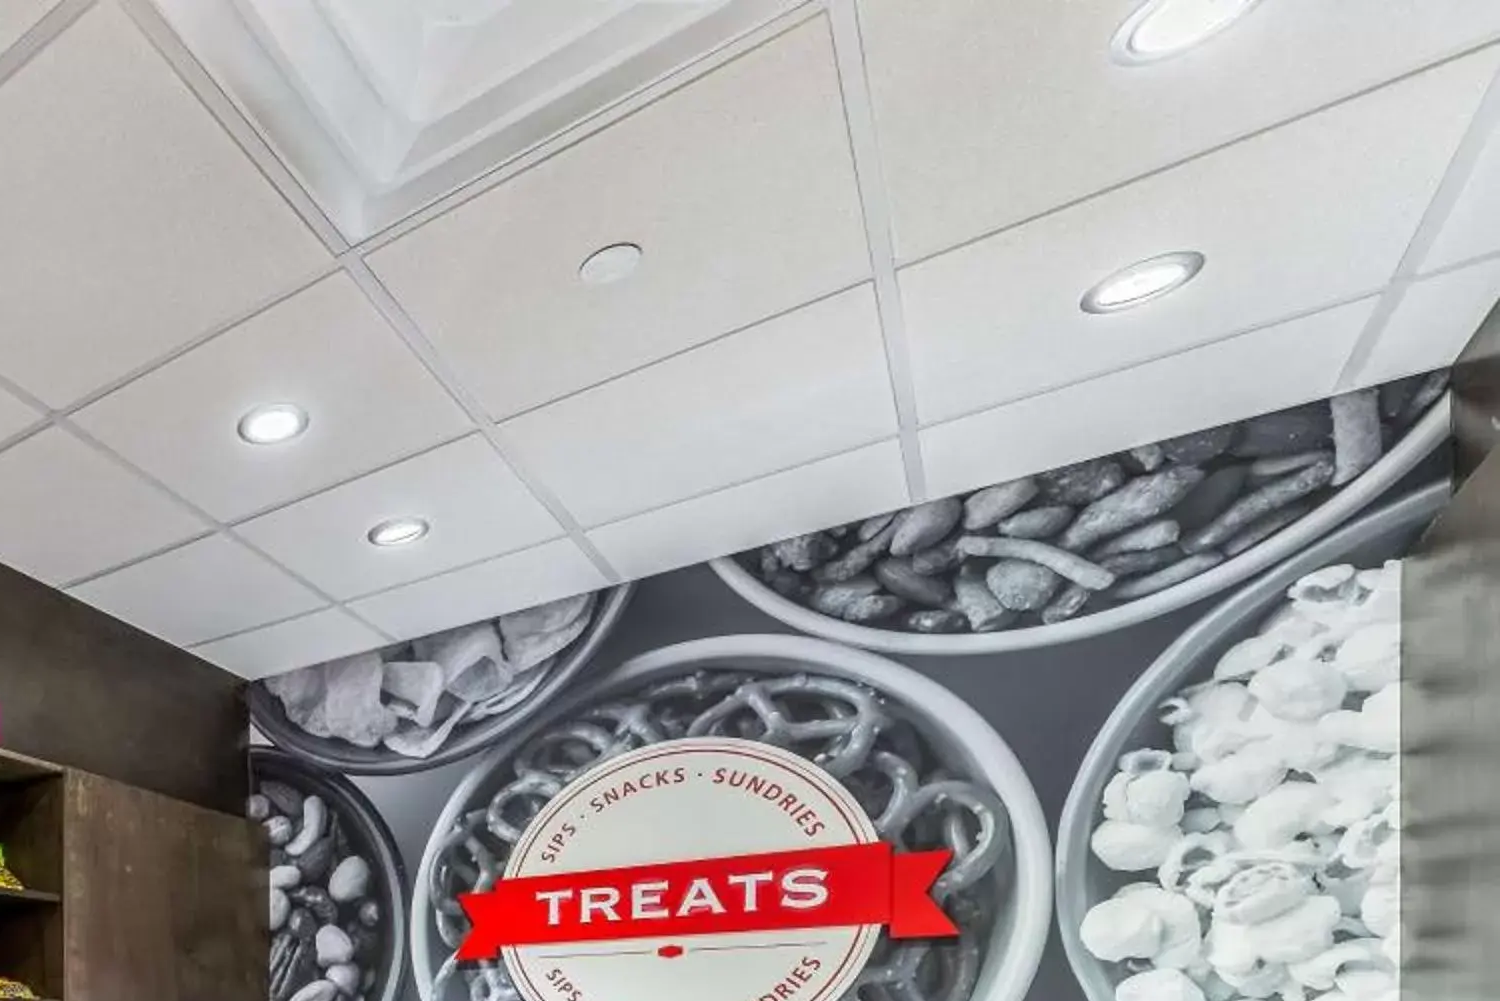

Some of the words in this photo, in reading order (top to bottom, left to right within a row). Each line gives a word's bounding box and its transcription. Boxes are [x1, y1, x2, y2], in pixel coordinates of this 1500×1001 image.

[541, 823, 576, 863] SIPS
[590, 767, 686, 813] SNACKS
[713, 767, 825, 837] SUNDRIES
[535, 868, 830, 926] TREATS
